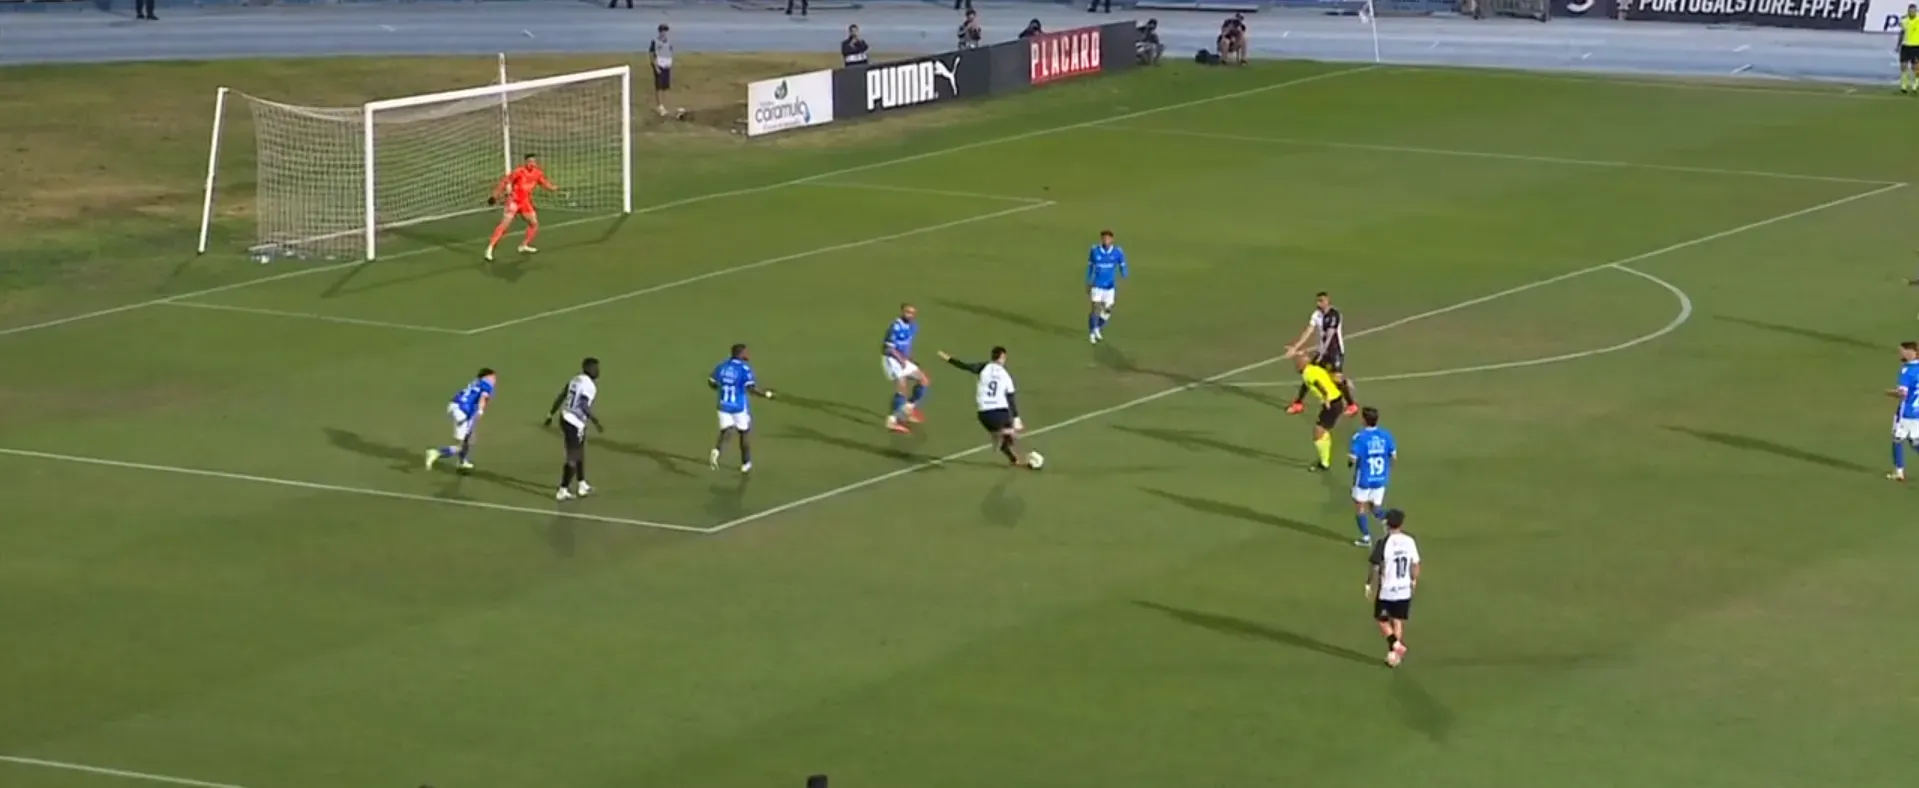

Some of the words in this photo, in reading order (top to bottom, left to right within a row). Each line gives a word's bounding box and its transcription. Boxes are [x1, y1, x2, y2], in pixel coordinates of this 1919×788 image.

[1030, 32, 1100, 79] PLACARD
[867, 61, 934, 110] PUMA
[722, 385, 736, 403] 11
[986, 380, 998, 397] 9
[1367, 456, 1385, 476] 19
[1394, 556, 1408, 579] 10
